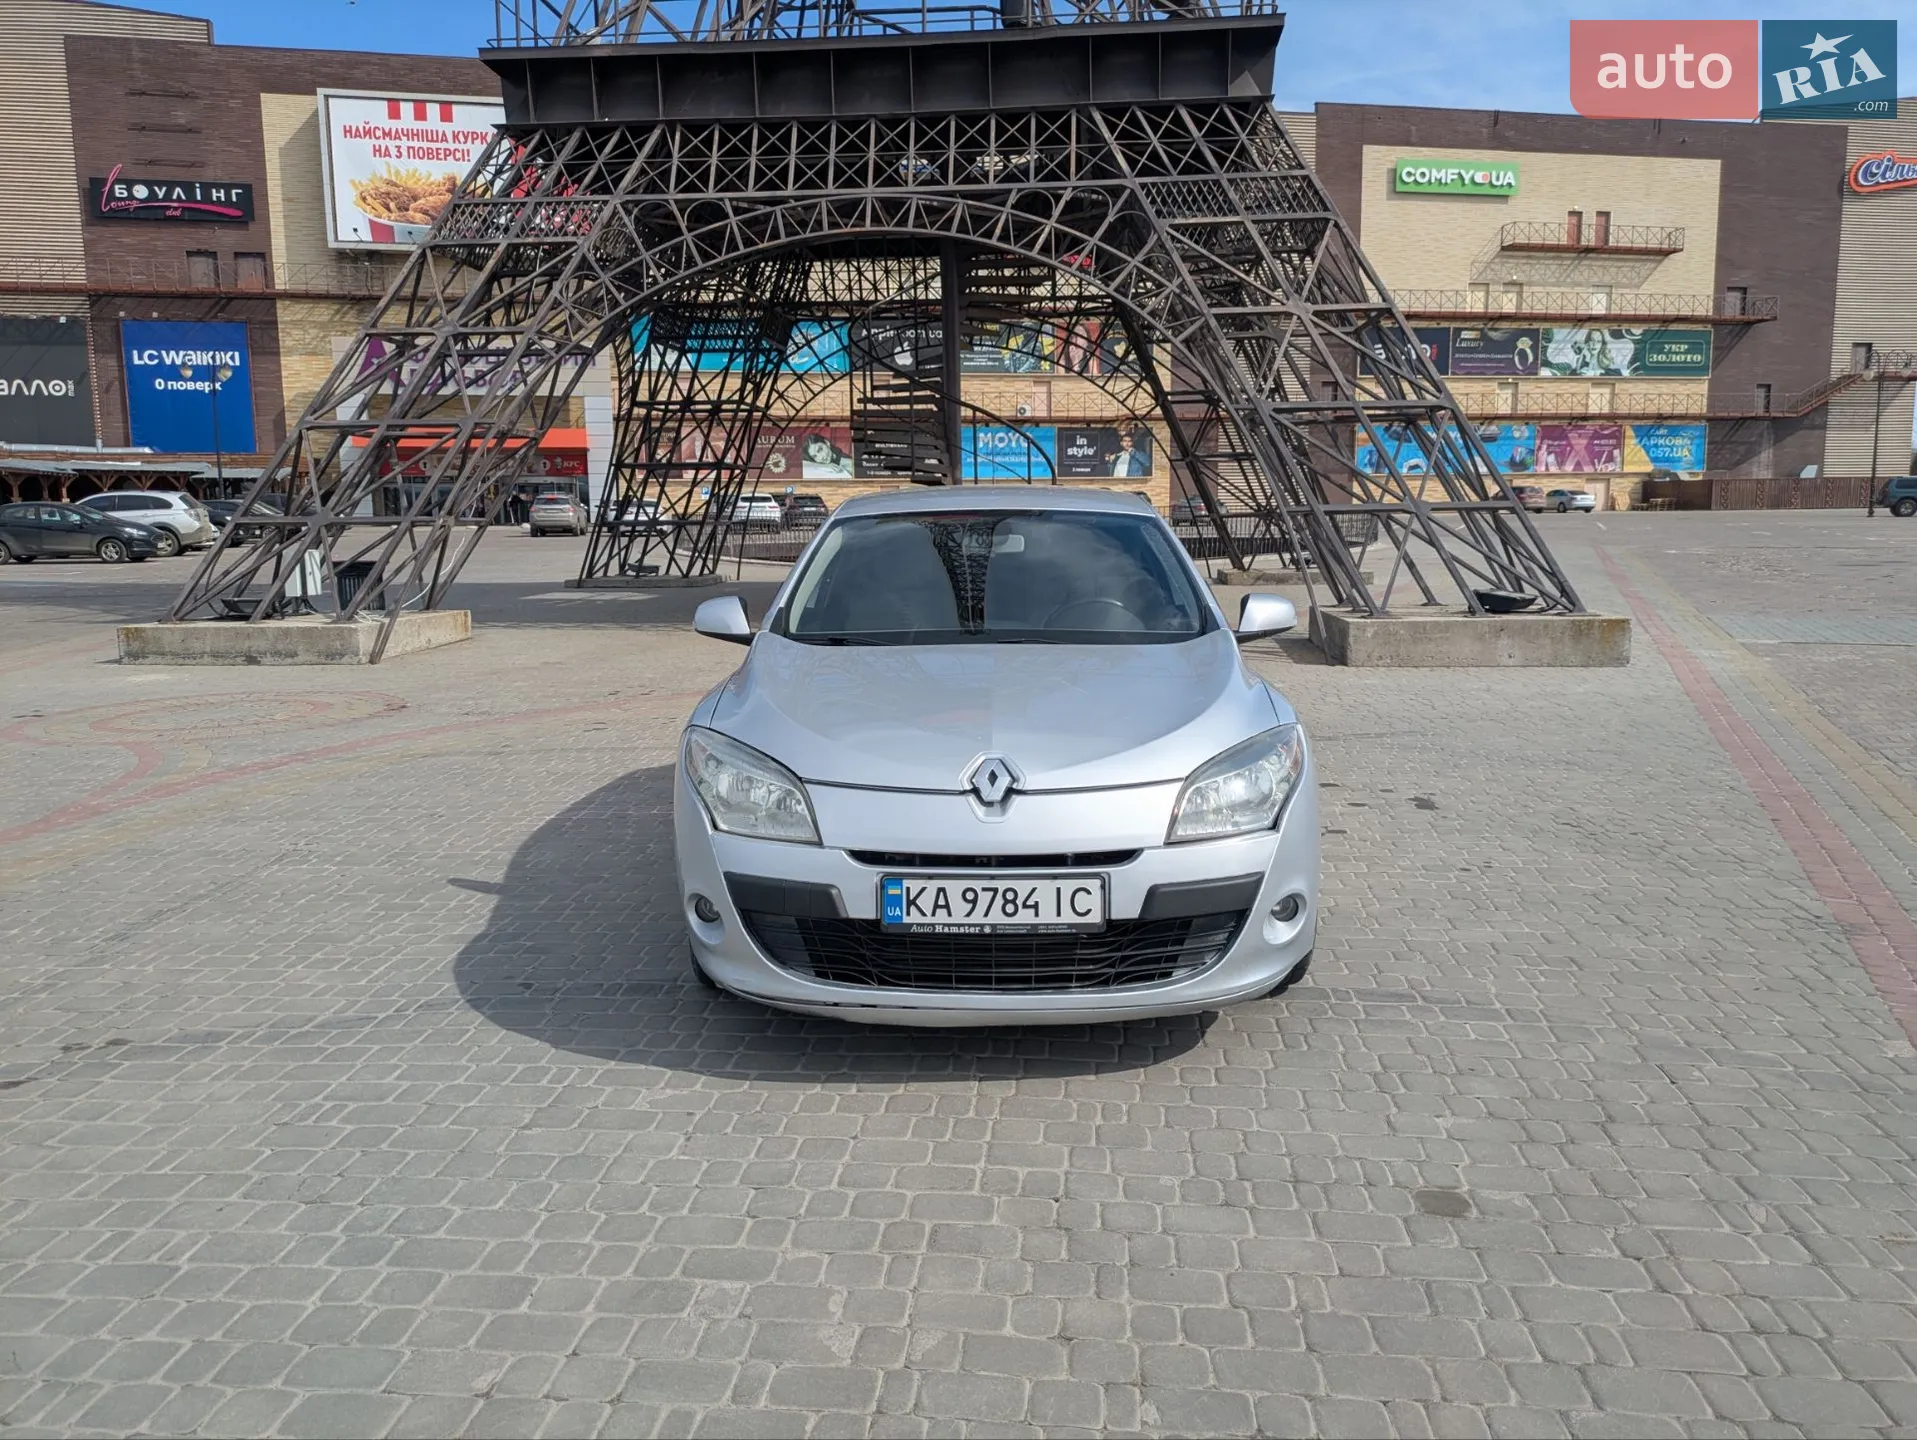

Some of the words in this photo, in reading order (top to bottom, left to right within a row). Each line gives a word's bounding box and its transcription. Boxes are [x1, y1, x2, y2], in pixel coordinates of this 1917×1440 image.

[343, 121, 449, 144] НАЙСМАЧНІША
[372, 144, 392, 159] НА
[395, 146, 403, 159] 3
[406, 146, 471, 162] ПОВЕРСІ!
[1663, 344, 1689, 352] УКР
[132, 349, 160, 366] LC
[1648, 353, 1702, 362] ЗОЛОТО
[979, 431, 1033, 448] MOYO
[1076, 435, 1087, 445] in
[563, 460, 581, 468] KFC
[905, 886, 952, 918] KA
[961, 886, 1040, 918] 9784
[1055, 886, 1093, 918] IC
[887, 906, 901, 917] UA
[910, 924, 933, 933] Auto
[935, 924, 981, 934] Hamster
